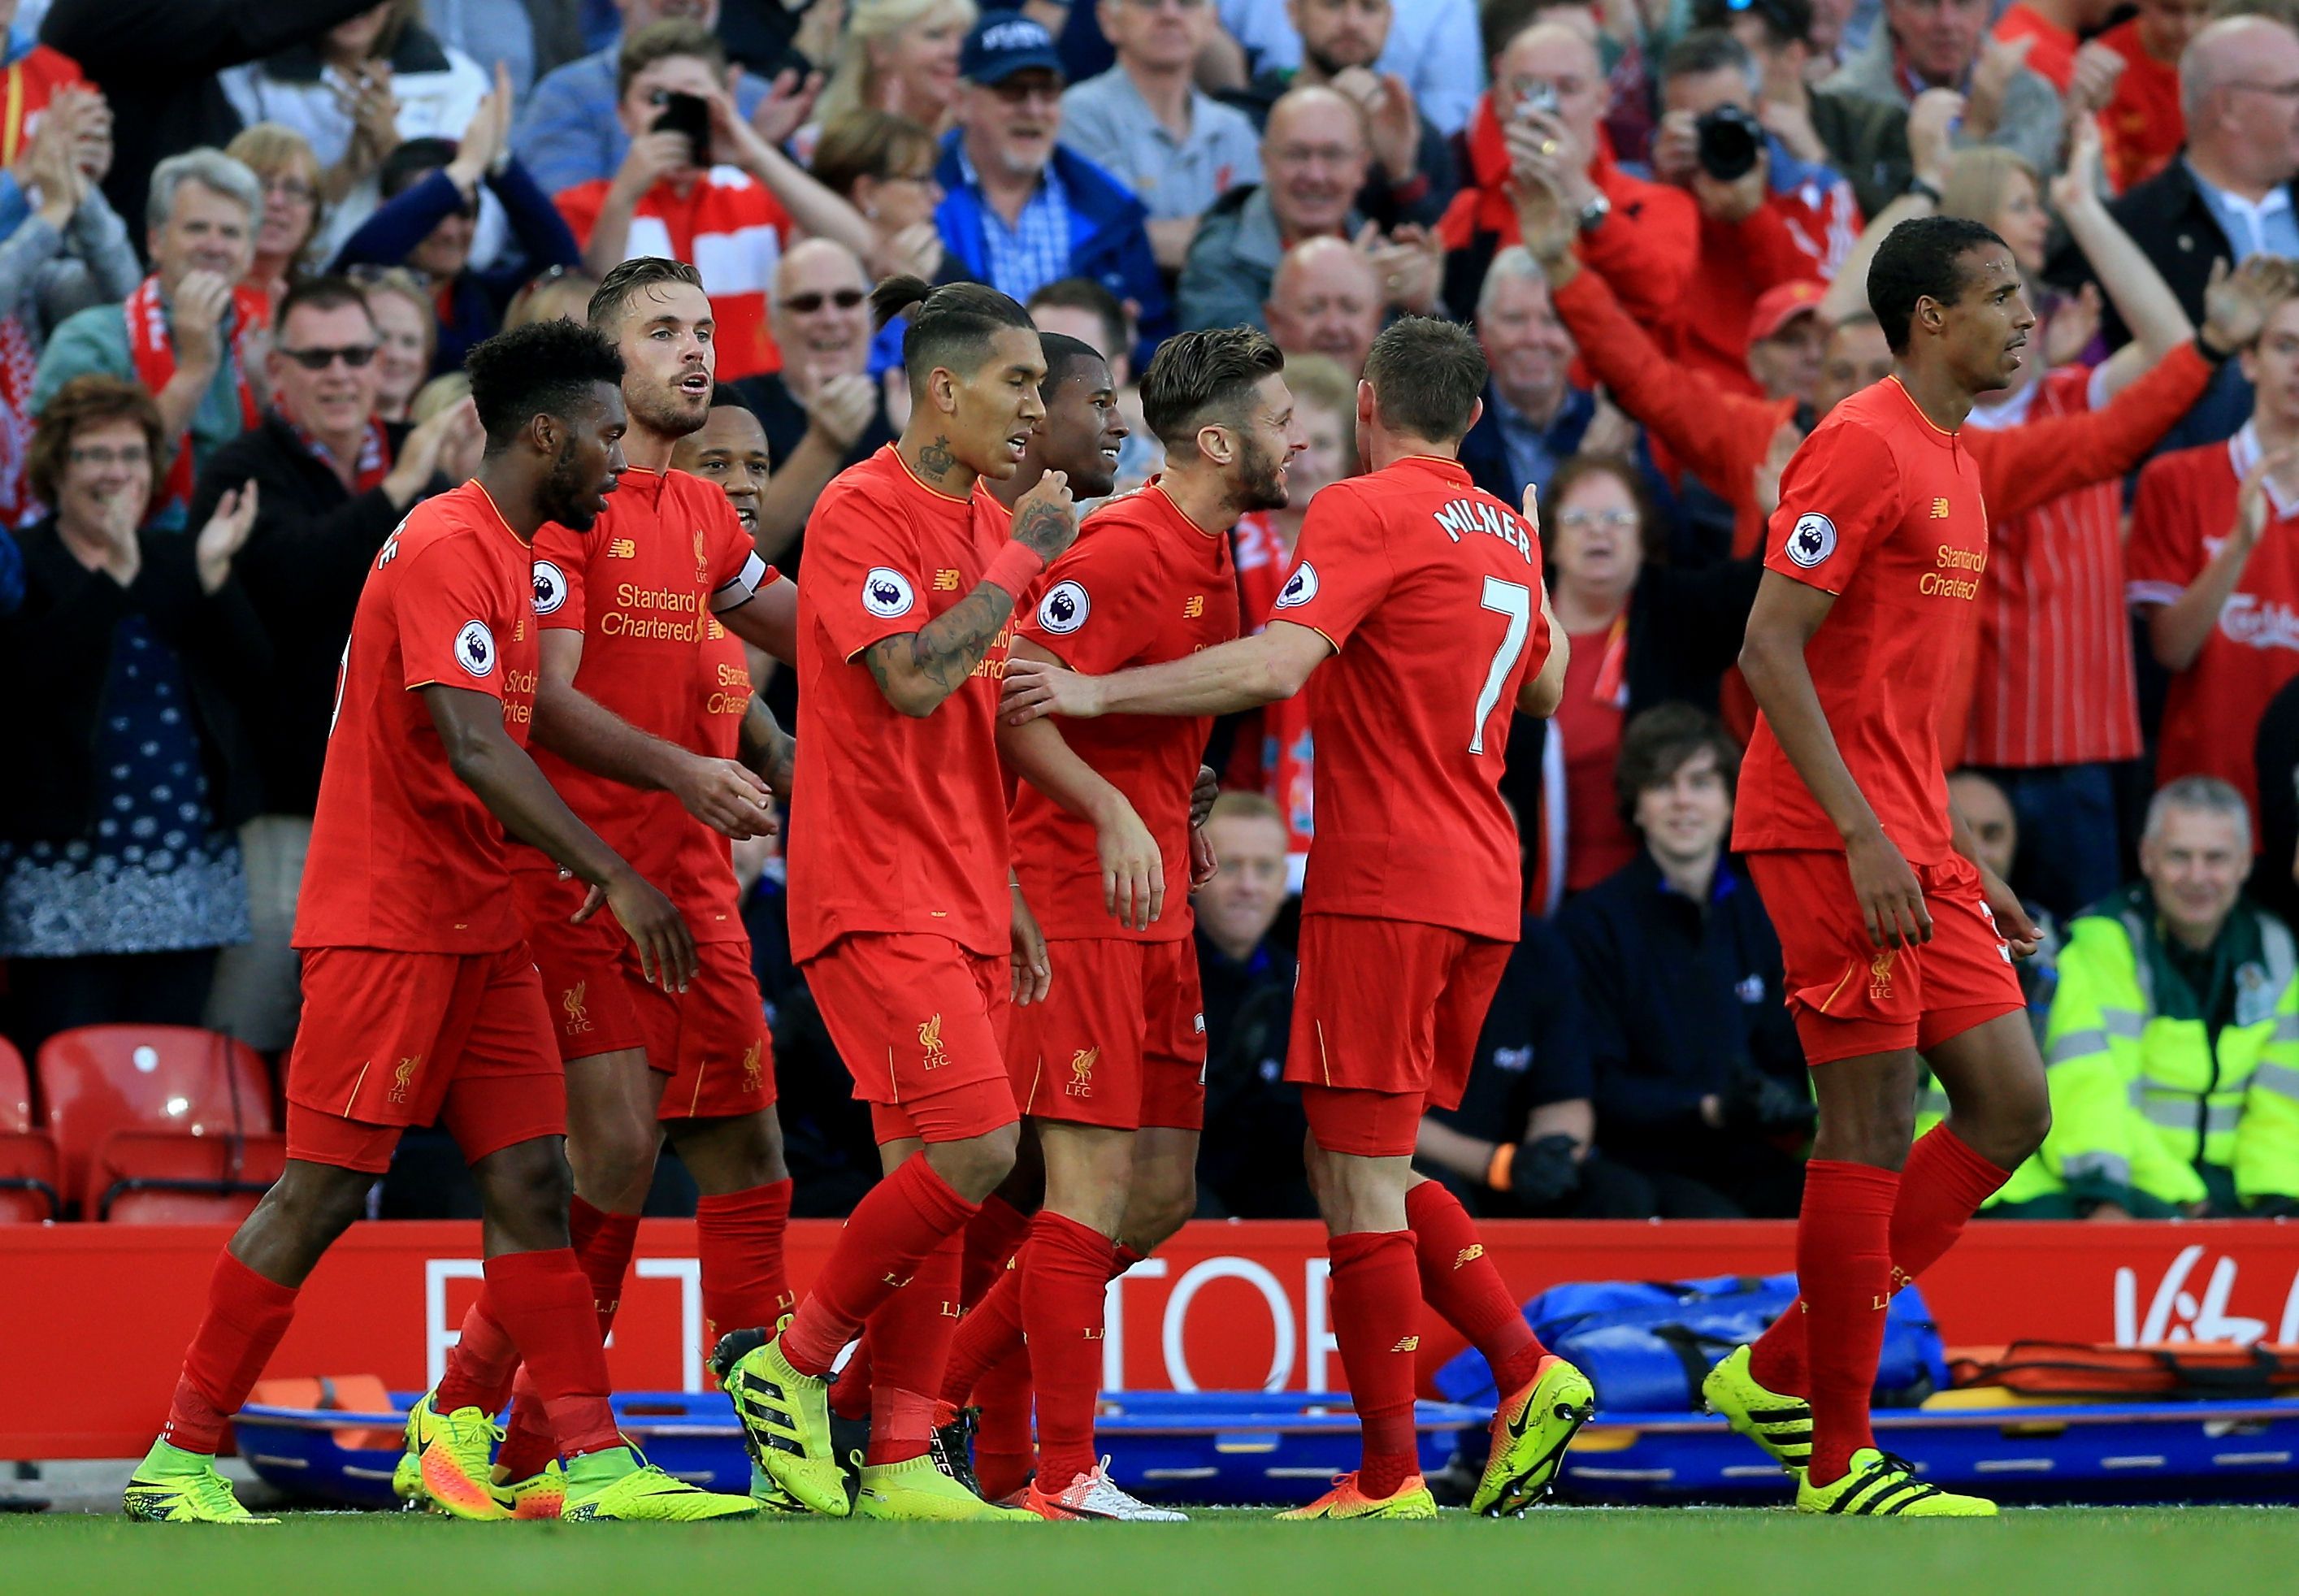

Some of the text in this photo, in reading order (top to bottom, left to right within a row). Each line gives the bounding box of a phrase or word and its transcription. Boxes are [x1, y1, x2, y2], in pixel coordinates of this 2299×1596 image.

[1433, 499, 1532, 565] MILNER
[616, 583, 696, 613] Standard
[601, 612, 694, 643] Chartered
[1468, 575, 1530, 754] 7
